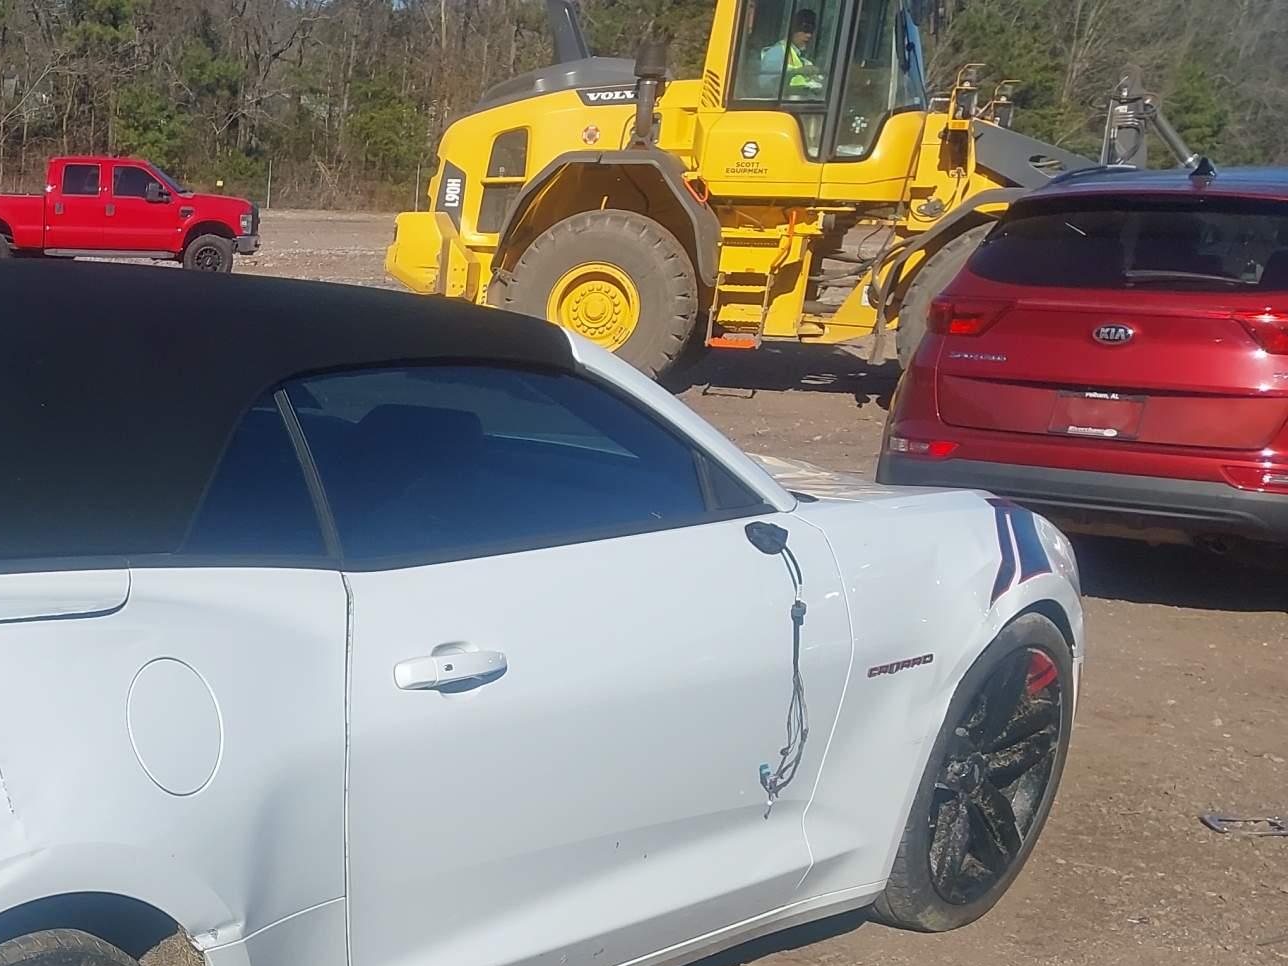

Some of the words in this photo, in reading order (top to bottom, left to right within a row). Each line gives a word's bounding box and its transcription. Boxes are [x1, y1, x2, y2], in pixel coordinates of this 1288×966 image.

[586, 90, 635, 101] VOLV
[444, 178, 462, 208] L90H
[1098, 327, 1127, 340] KIA
[867, 653, 934, 678] CAMARO
